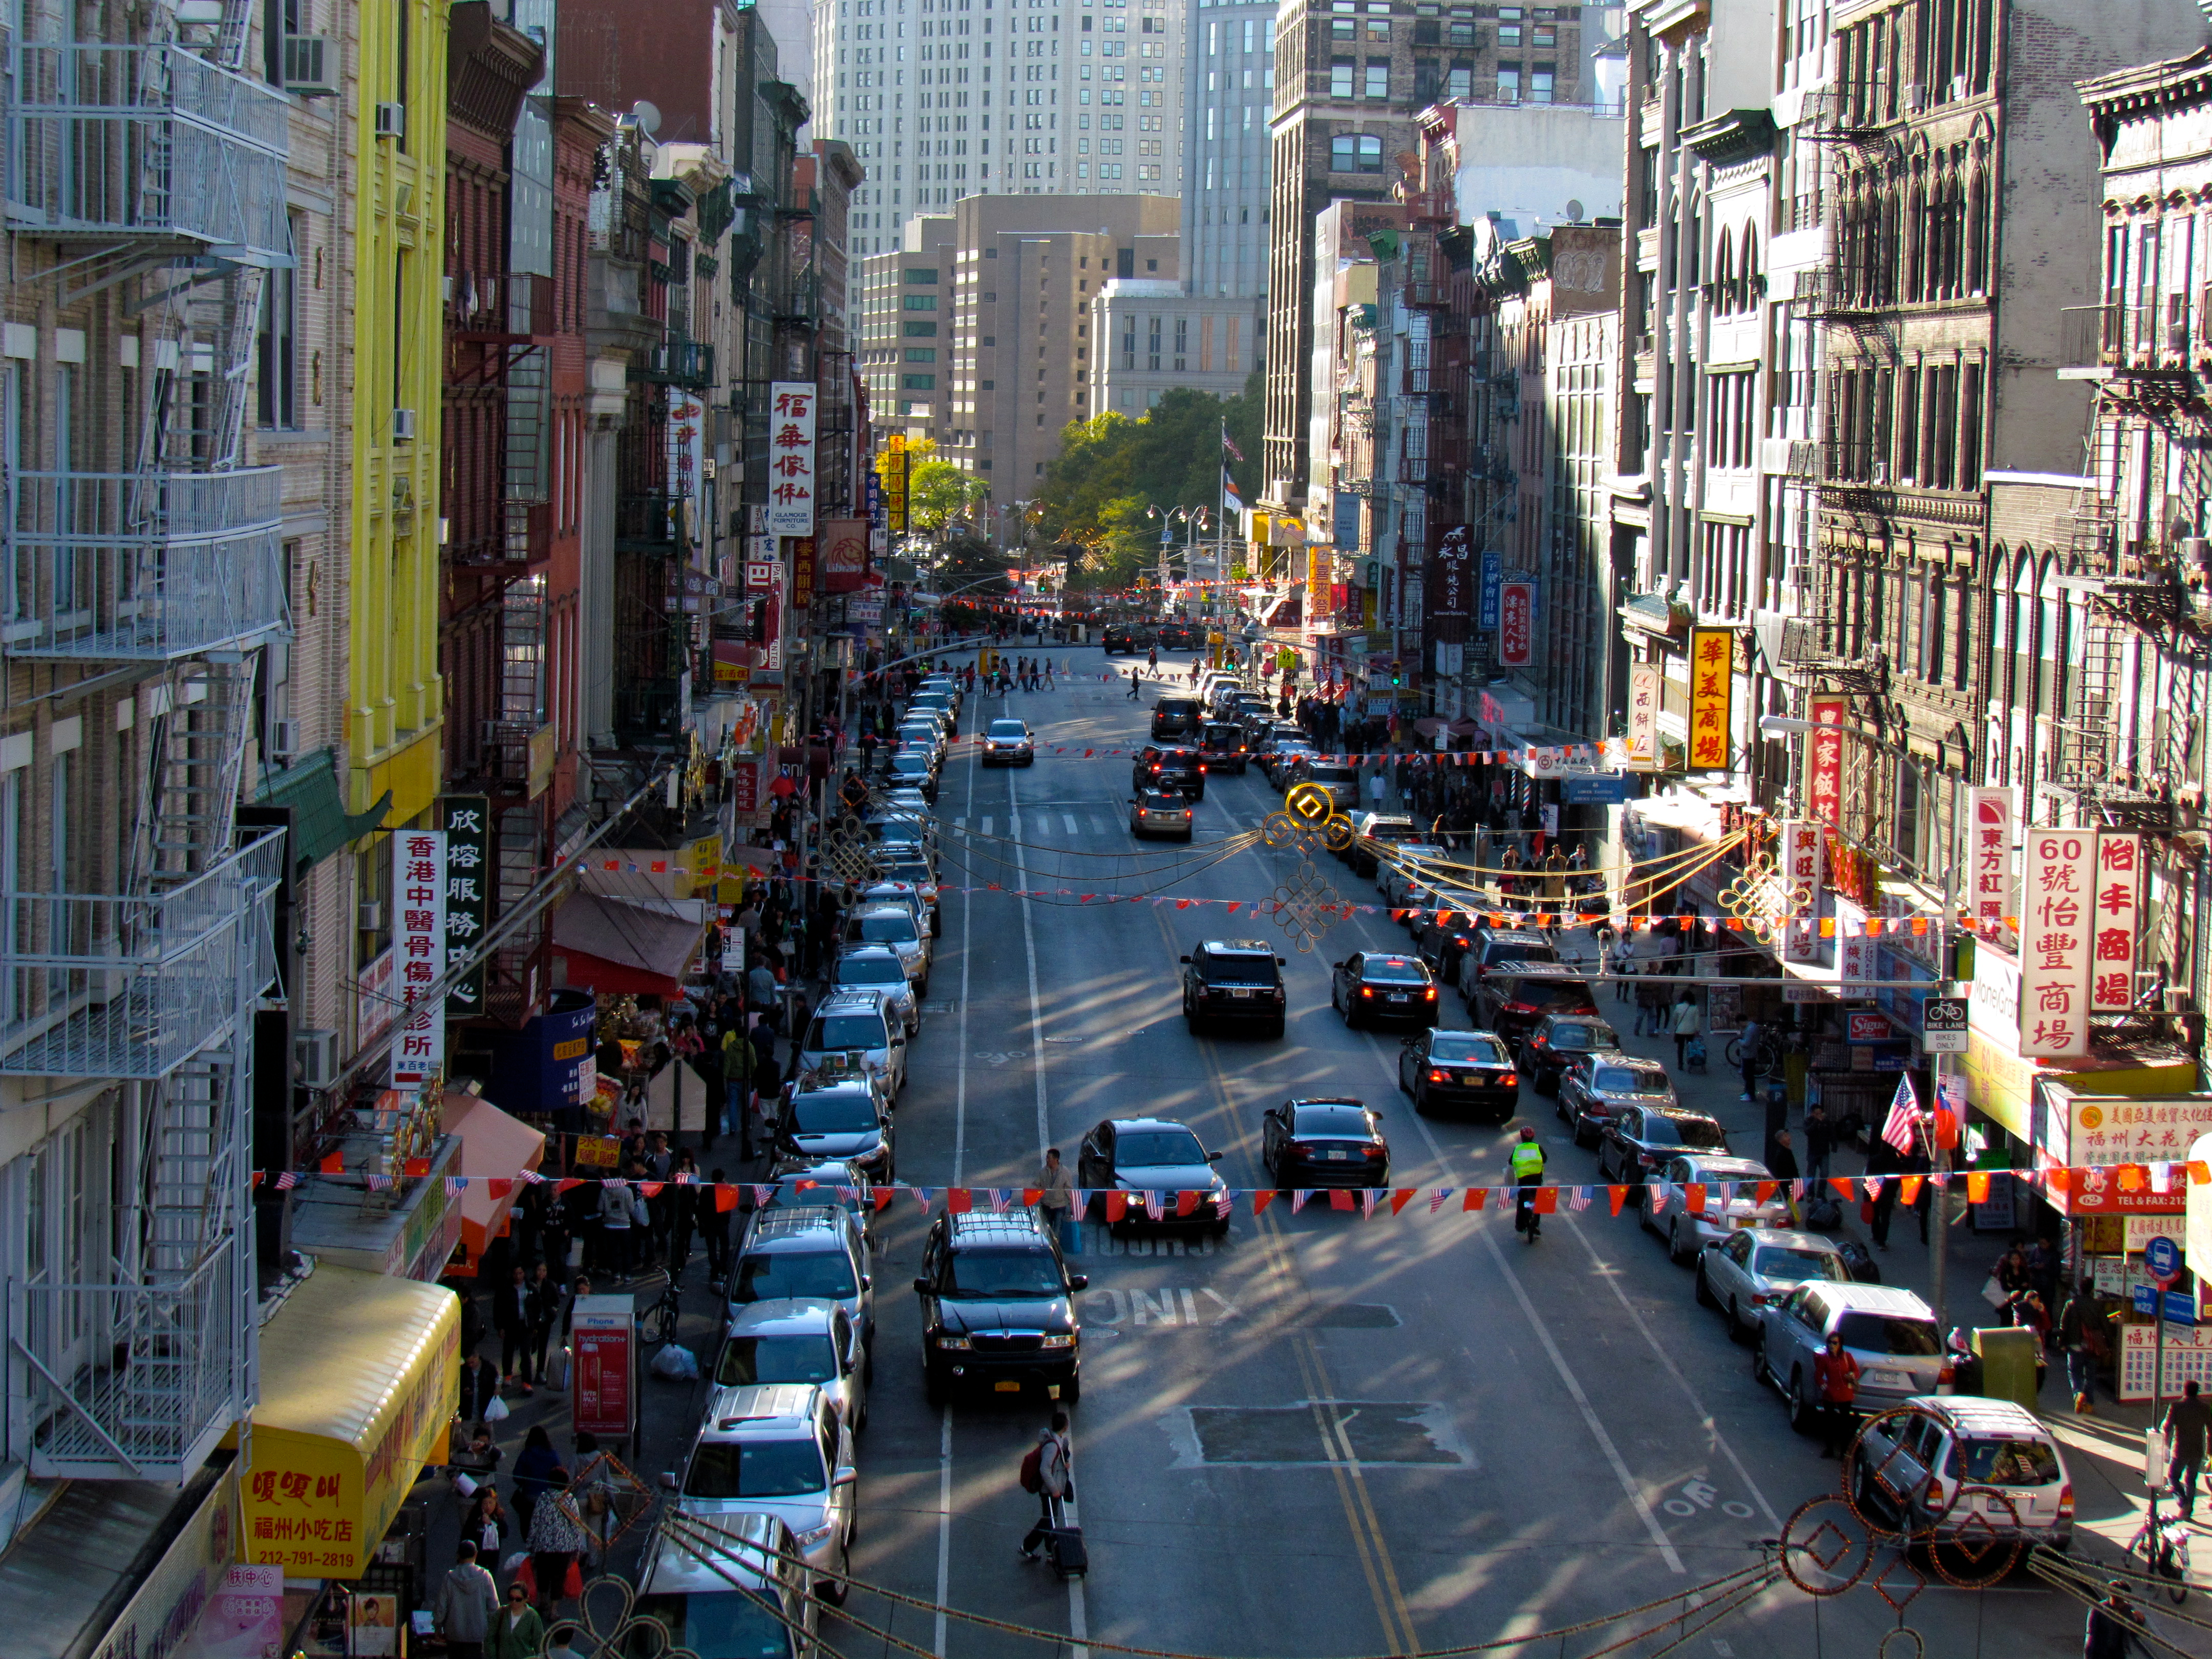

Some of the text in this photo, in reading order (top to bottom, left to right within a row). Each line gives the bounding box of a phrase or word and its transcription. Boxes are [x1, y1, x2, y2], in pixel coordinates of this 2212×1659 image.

[773, 565, 781, 583] PAR
[826, 563, 862, 573] Library
[1315, 565, 1329, 614] 喜來登
[1694, 637, 1725, 764] 華美商場
[446, 810, 482, 1003] 欣榕服務中心
[402, 837, 436, 1056] 香港中醫骨傷科診所
[1845, 938, 1862, 995] 機維修
[397, 1060, 431, 1071] 東百老
[2117, 1196, 2186, 1205] TEL & FAX: 212
[1084, 1288, 1243, 1326] XING
[2135, 1302, 2153, 1314] M22
[578, 1334, 626, 1343] hydration+
[254, 1516, 353, 1542] 福州小吃店
[259, 1550, 354, 1567] 212-791-2819
[228, 1568, 274, 1587] 肤中心
